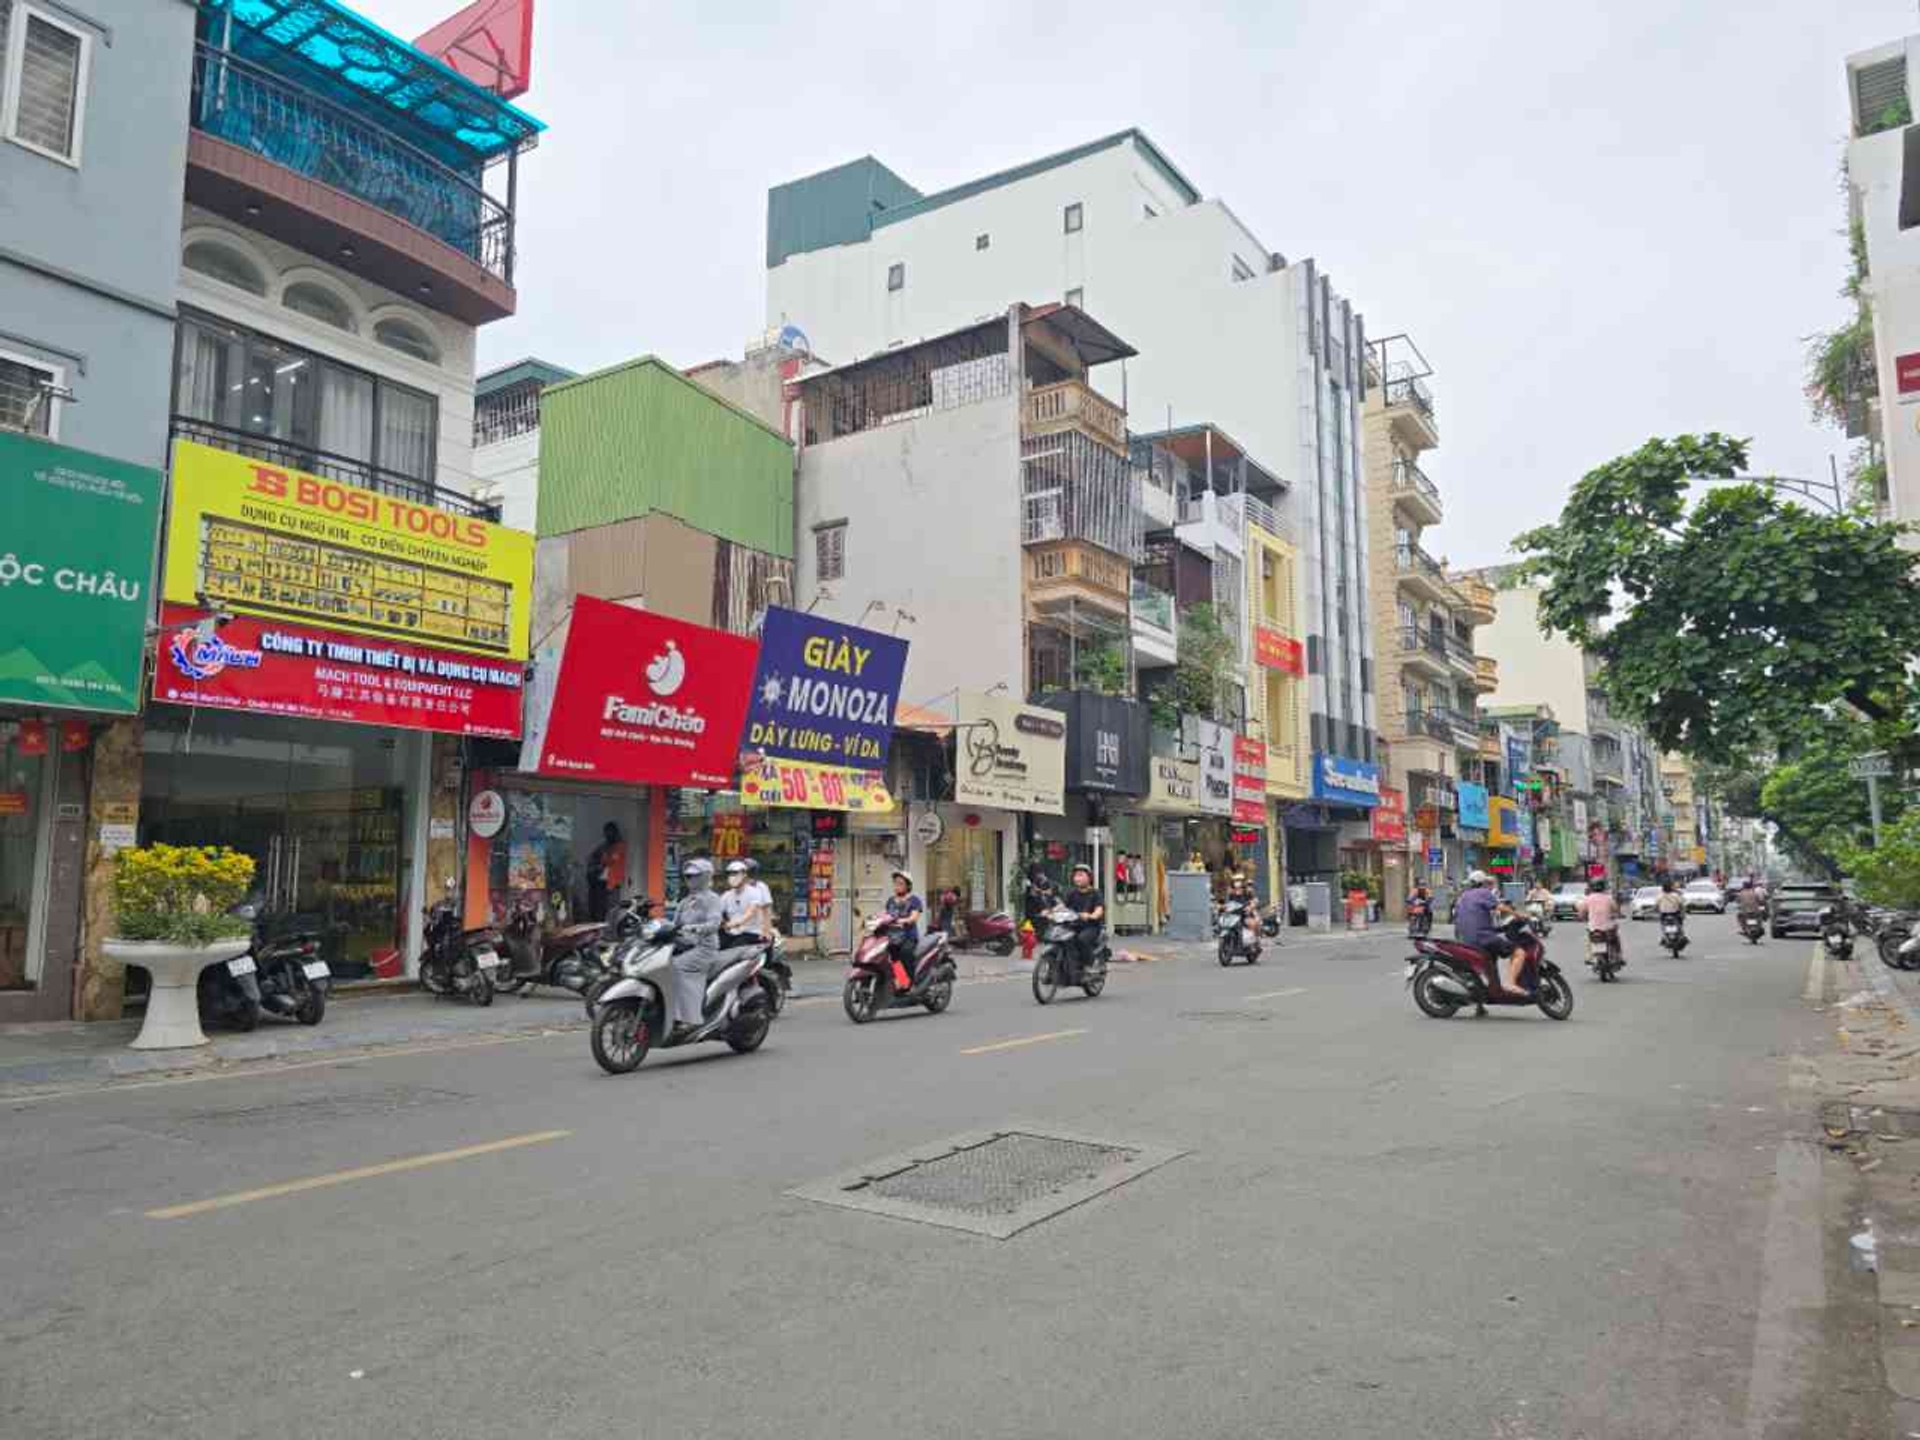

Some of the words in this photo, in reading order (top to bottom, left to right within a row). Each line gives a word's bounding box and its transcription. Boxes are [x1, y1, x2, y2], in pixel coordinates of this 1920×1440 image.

[240, 503, 277, 523] DỤNG
[280, 513, 297, 530] CỤ
[297, 476, 379, 522] BOSI
[388, 501, 487, 547] TOOLS
[54, 569, 140, 601] CHÂU
[307, 637, 323, 656] TY
[365, 648, 399, 668] THIẾT
[402, 655, 416, 675] BỊ
[418, 655, 435, 674] VÀ
[437, 660, 471, 679] DỤNG
[472, 666, 488, 685] CỤ
[488, 669, 521, 688] MACH
[803, 634, 872, 676] GIÀY
[314, 667, 350, 684] MACH
[353, 672, 382, 688] TOOL
[394, 678, 452, 697] EQUIPMENT
[454, 688, 473, 700] LLC
[786, 675, 889, 726] MONOZA
[603, 695, 706, 733] FamiCháo
[750, 718, 788, 747] DÂY
[843, 732, 860, 757] VÍ
[860, 739, 881, 760] DA
